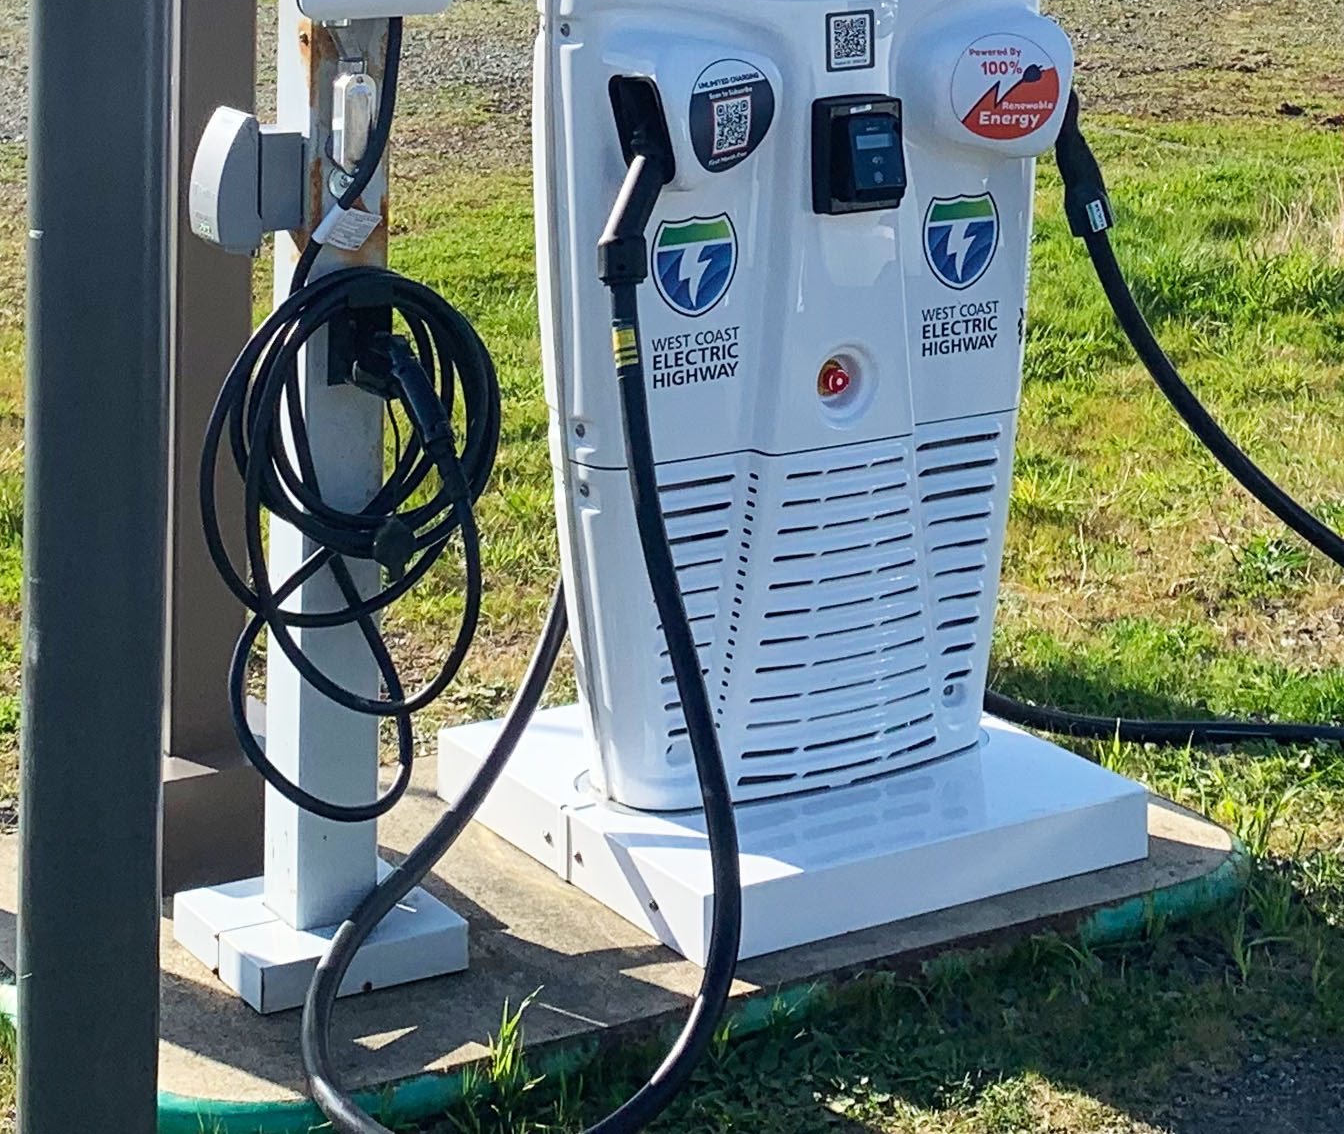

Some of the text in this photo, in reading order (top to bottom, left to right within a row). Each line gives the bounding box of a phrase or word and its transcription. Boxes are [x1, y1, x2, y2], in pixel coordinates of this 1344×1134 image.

[969, 47, 1022, 57] Powered By
[980, 60, 1023, 75] 100%
[698, 72, 759, 89] UNLIMITED CHARGING
[1002, 100, 1053, 110] Renewable
[979, 110, 1040, 128] Energy
[921, 300, 1000, 322] WEST COAST
[922, 315, 998, 340] ELECTRIC
[652, 326, 740, 352] WEST COAST
[922, 333, 997, 357] HIGHWAY
[653, 342, 739, 371] ELECTRIC
[653, 361, 739, 389] HIGHWAY
